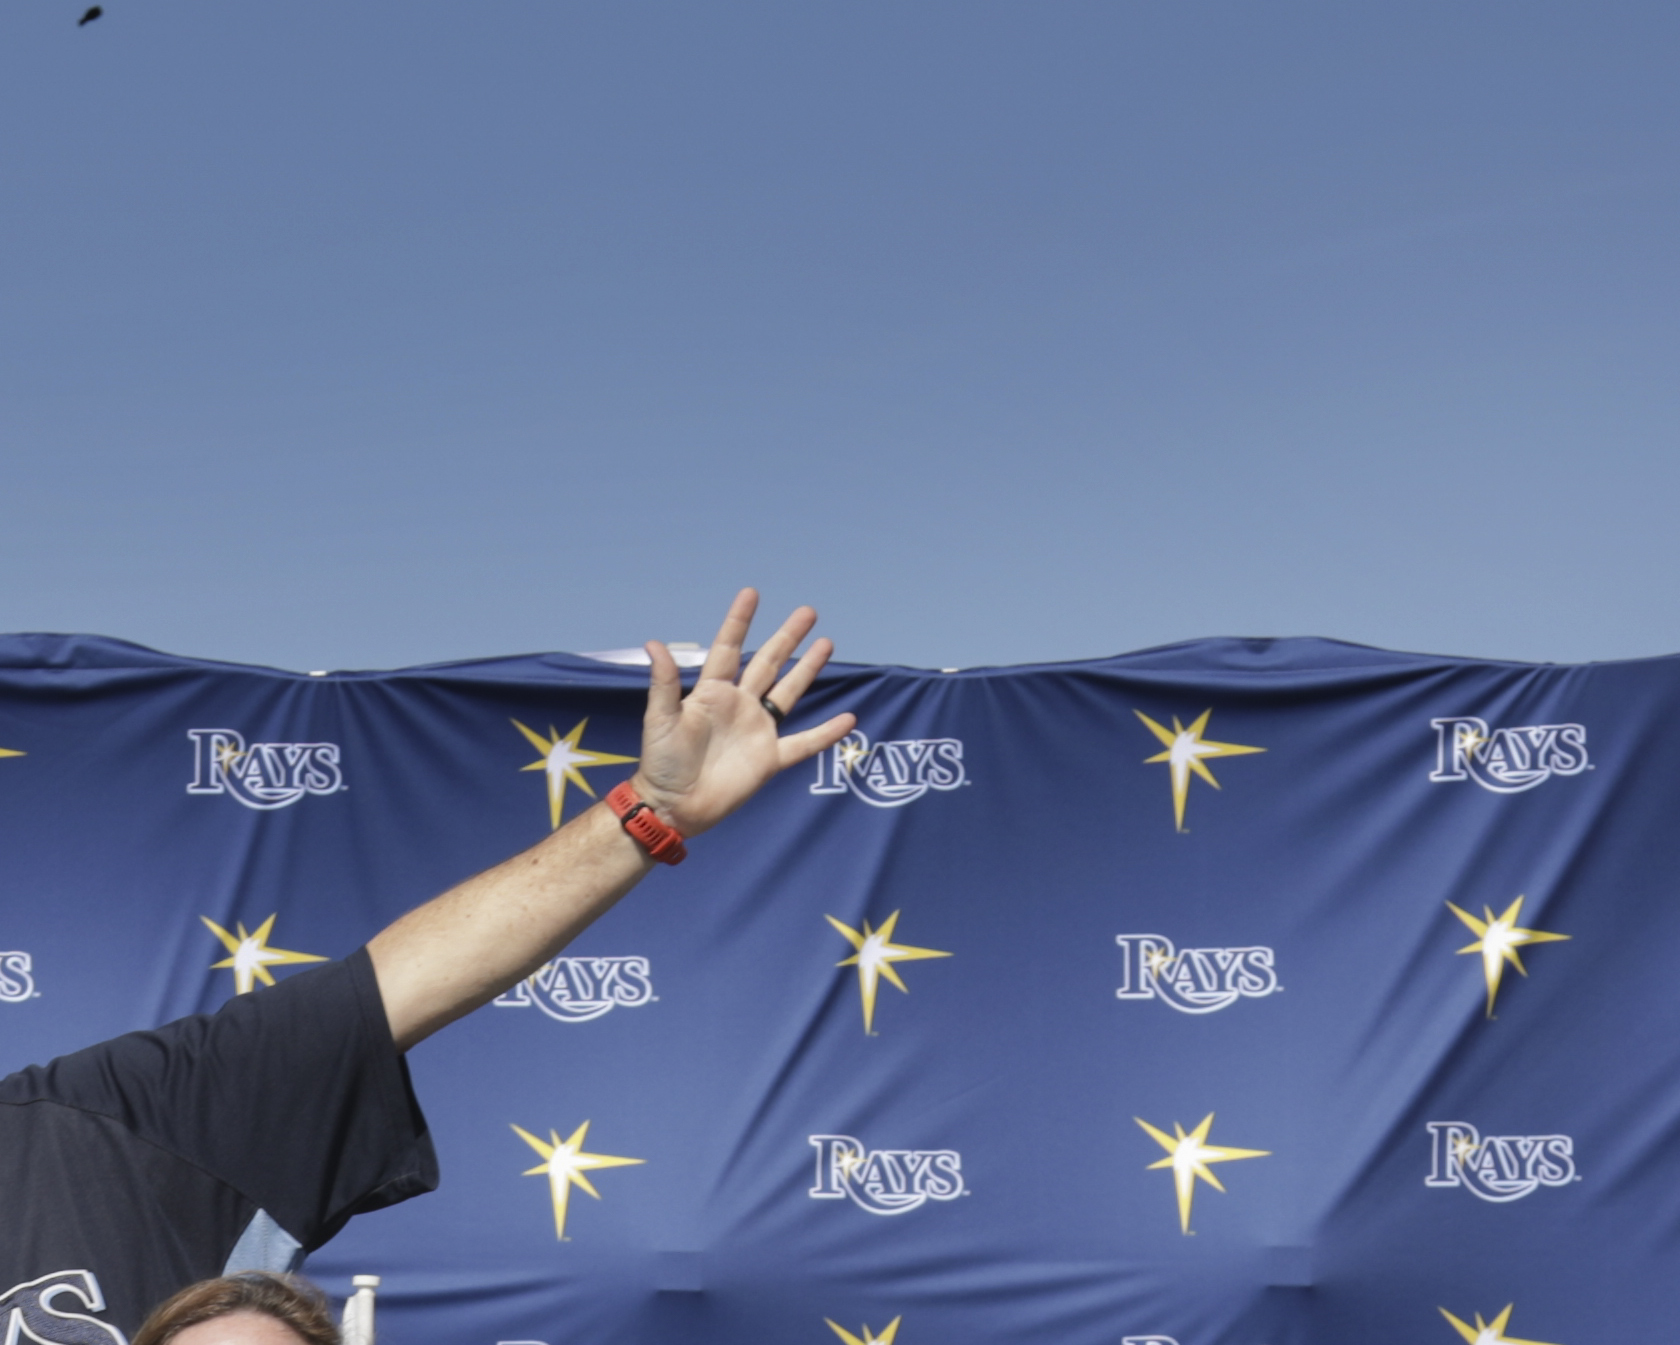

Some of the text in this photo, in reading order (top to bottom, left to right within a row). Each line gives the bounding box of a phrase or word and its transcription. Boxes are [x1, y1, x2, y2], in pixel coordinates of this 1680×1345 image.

[188, 728, 342, 810] RAYS
[811, 728, 965, 806] RAYS
[1429, 717, 1588, 792] RAYS
[1116, 933, 1277, 1013] RAYS
[809, 1134, 963, 1215] RAYS
[1426, 1121, 1576, 1202] RAYS
